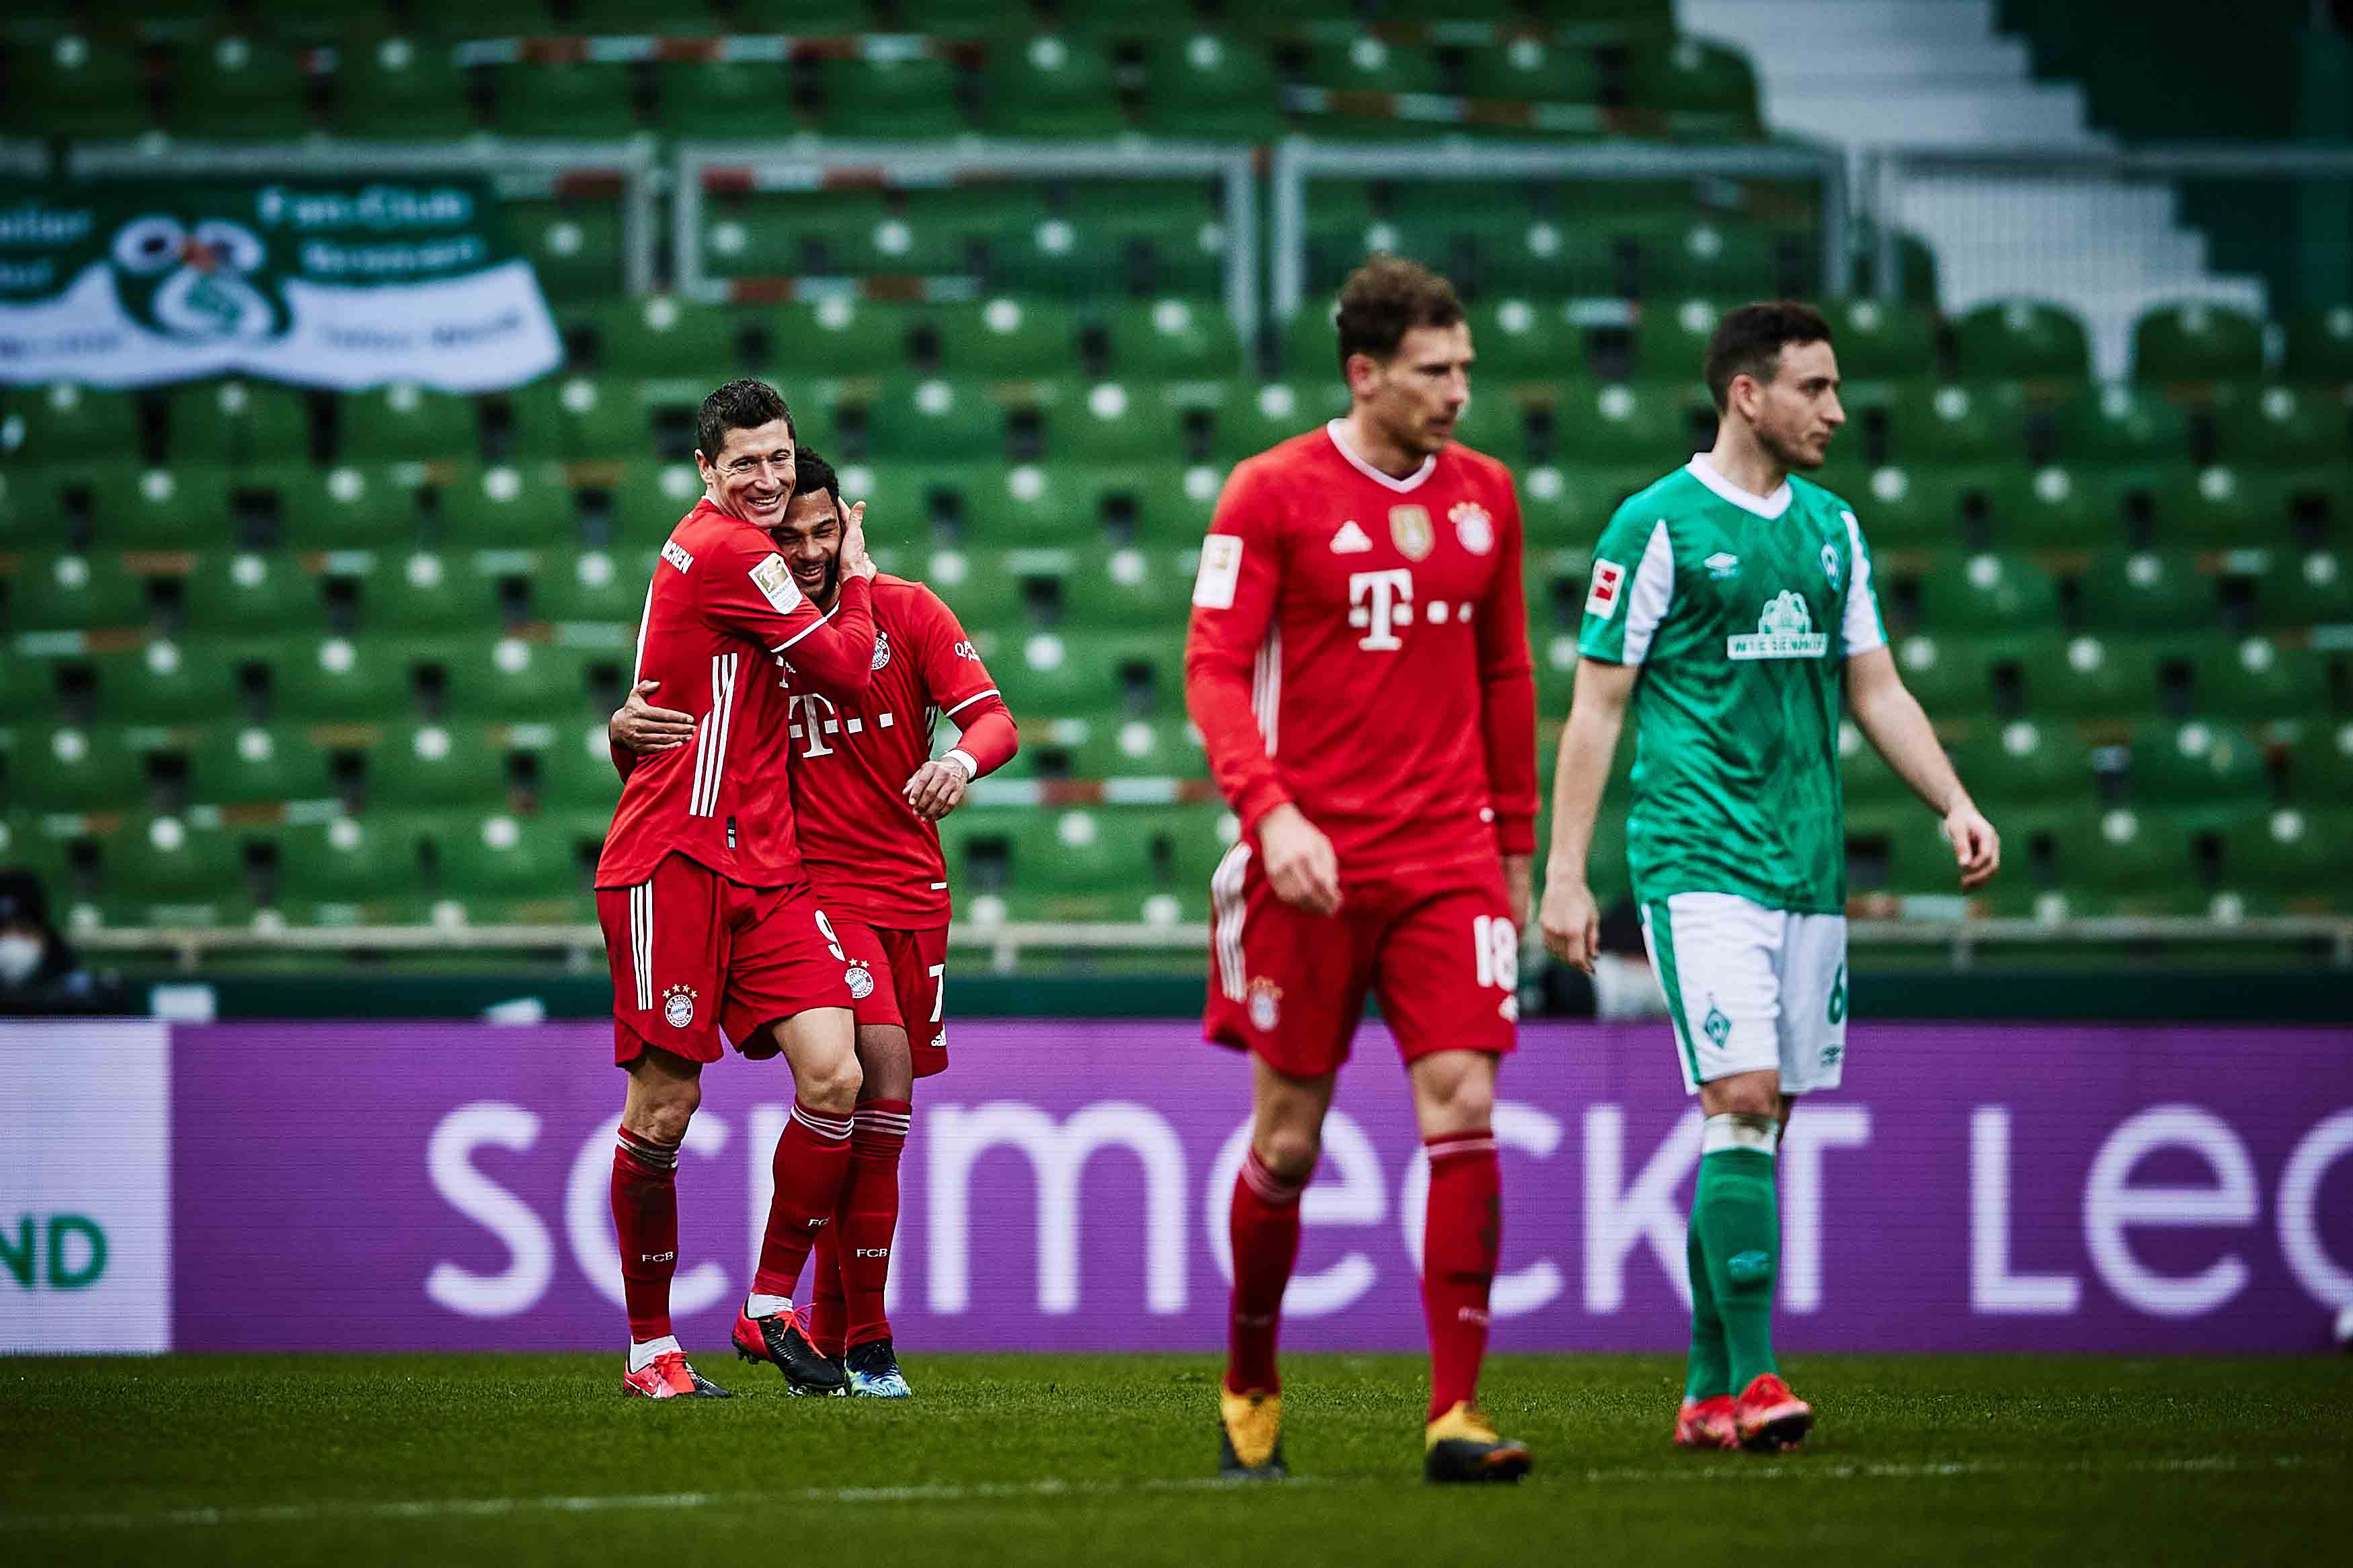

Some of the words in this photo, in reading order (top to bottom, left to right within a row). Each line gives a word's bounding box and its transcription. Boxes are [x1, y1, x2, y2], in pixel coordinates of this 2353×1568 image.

[815, 909, 846, 962] 9
[1473, 914, 1519, 991] 18
[928, 963, 945, 1022] 7
[642, 1251, 674, 1262] FCB
[856, 1248, 887, 1257] FCB
